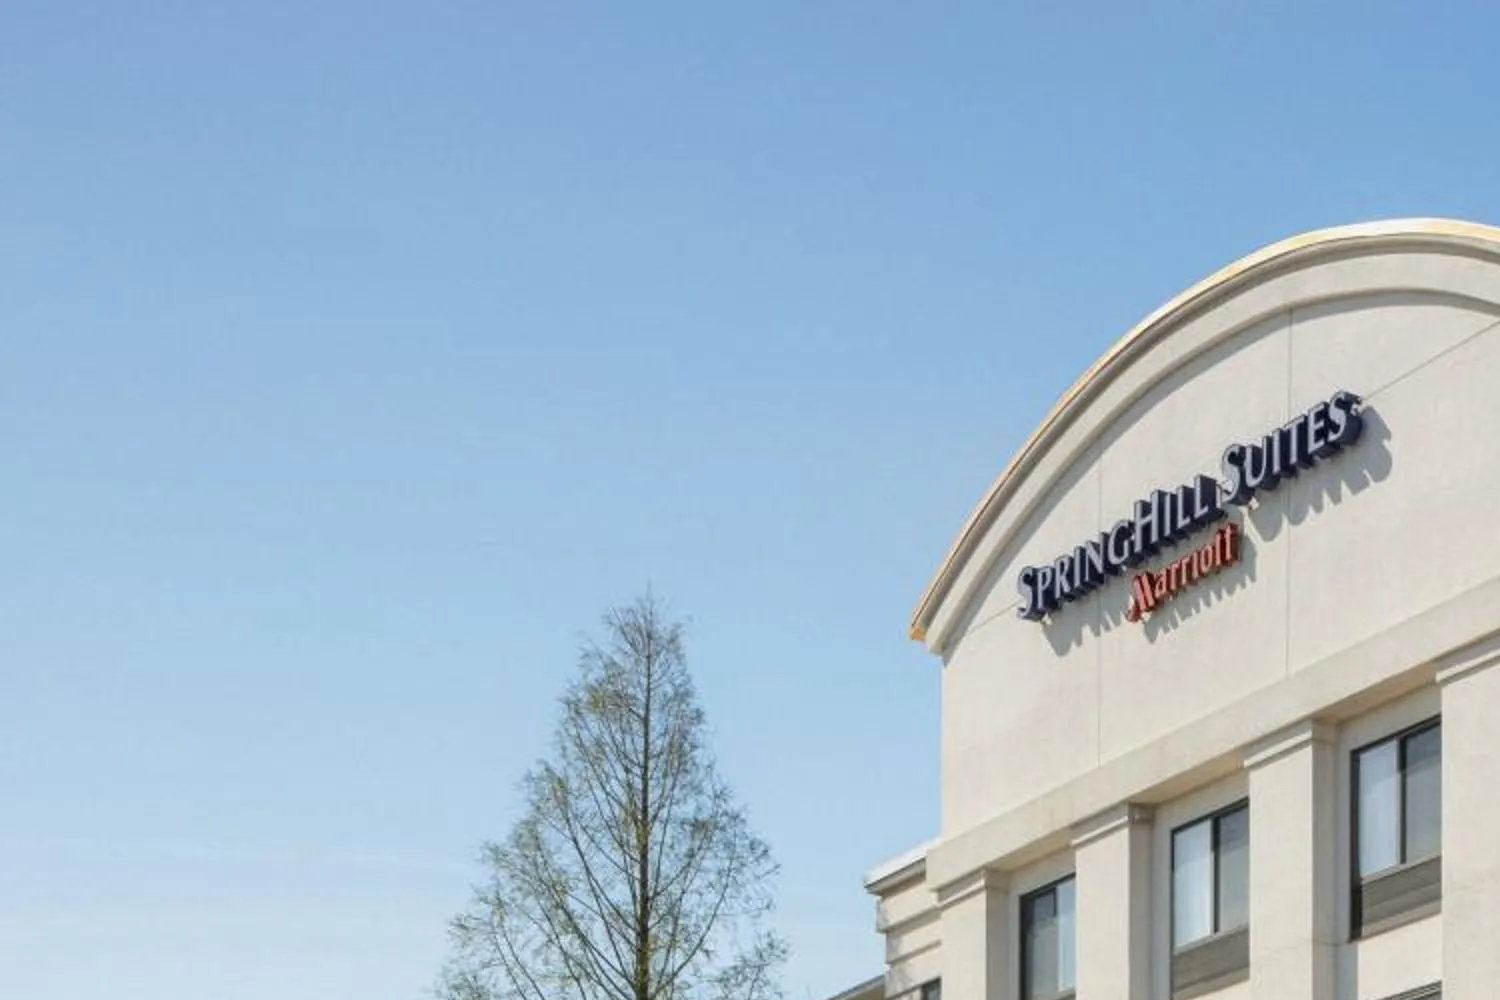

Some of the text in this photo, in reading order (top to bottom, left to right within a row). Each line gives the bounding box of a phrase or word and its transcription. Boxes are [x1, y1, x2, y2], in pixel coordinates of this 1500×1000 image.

[1017, 390, 1363, 622] SPRINGHILL SUITES
[1126, 523, 1240, 623] Marriott
